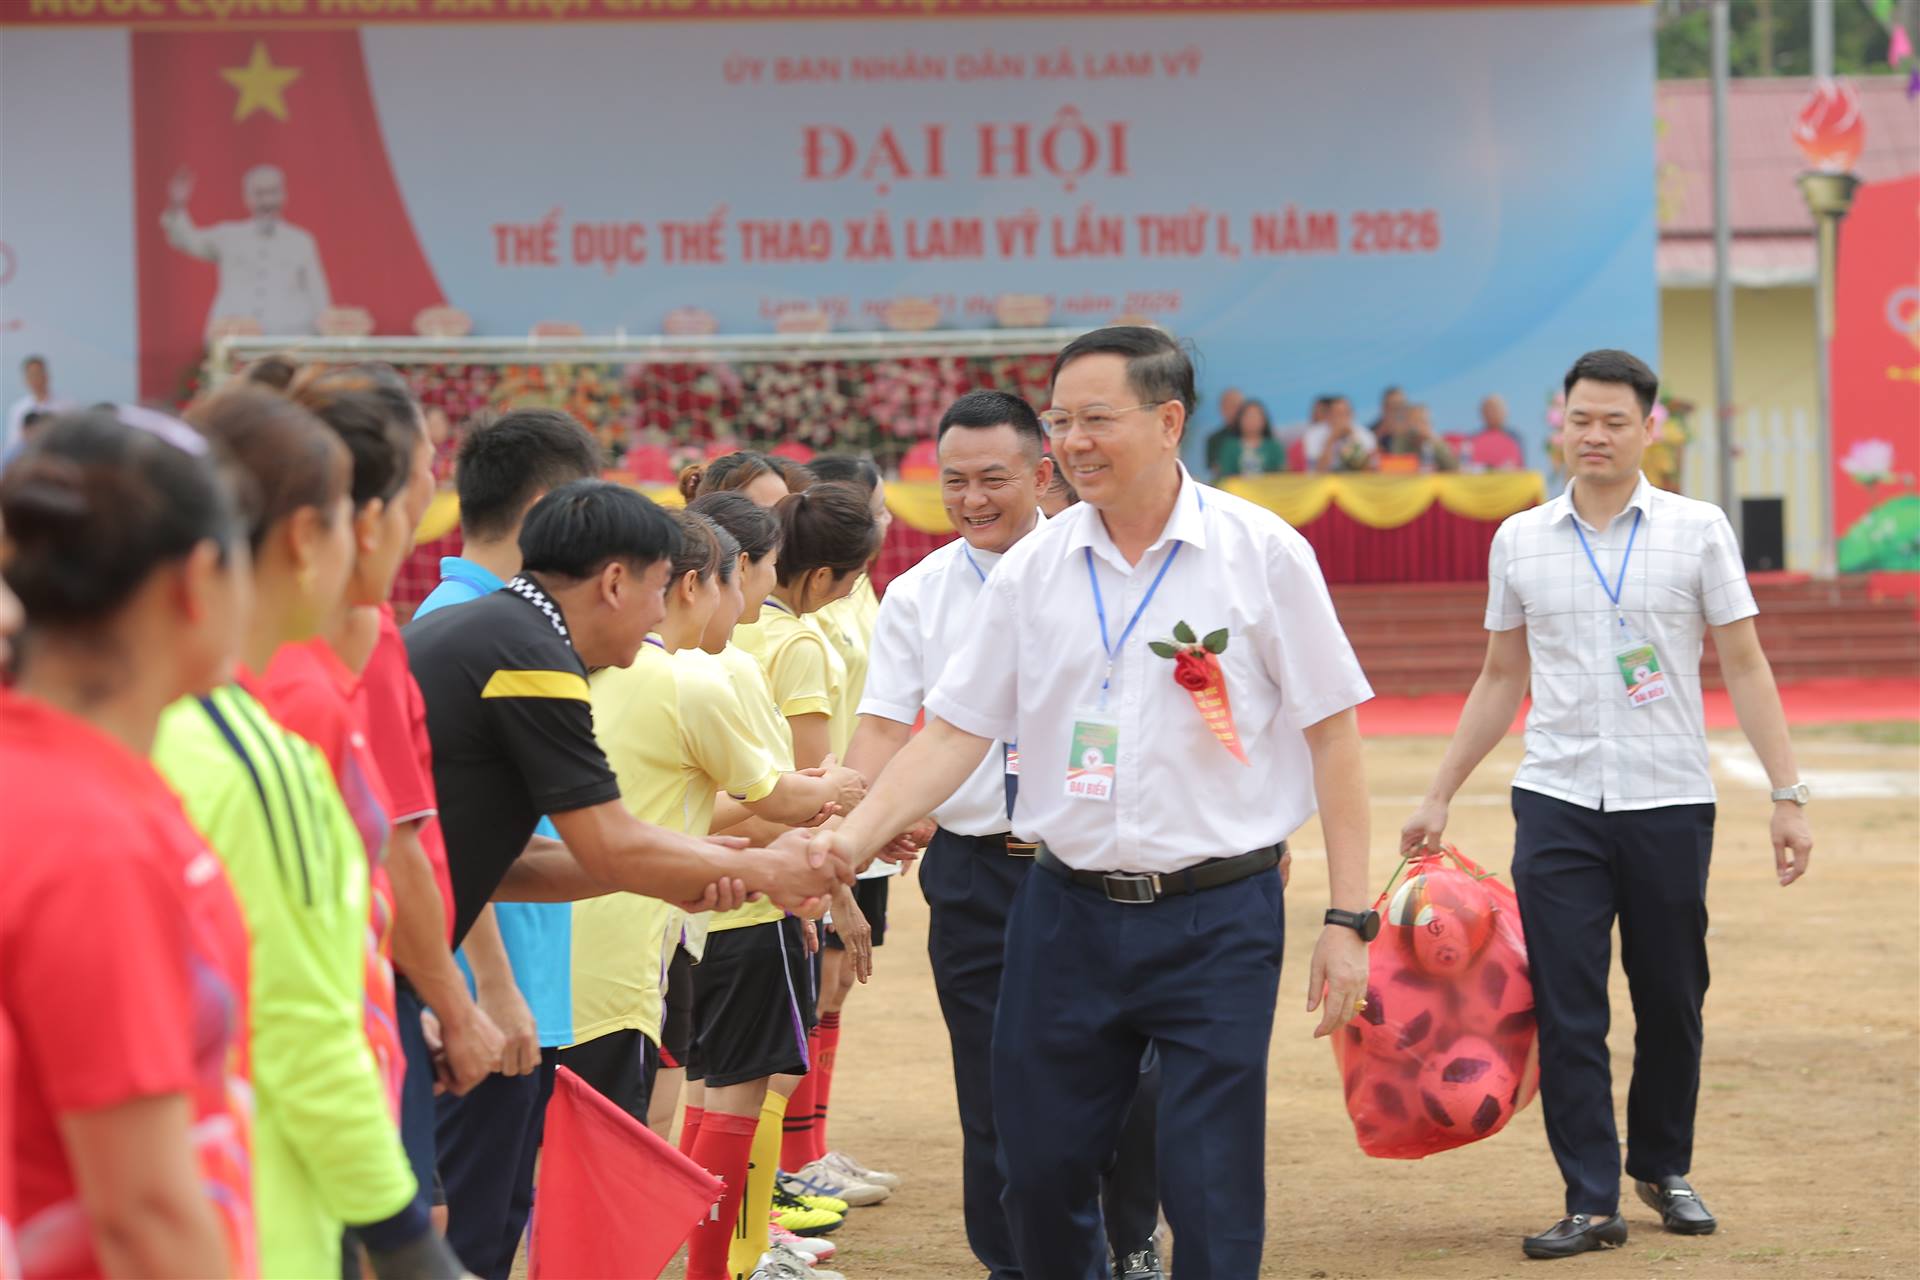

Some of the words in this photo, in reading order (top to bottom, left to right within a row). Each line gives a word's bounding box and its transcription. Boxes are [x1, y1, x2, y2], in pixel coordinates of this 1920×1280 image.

[773, 53, 841, 82] BAN
[851, 48, 946, 81] NHÂN
[955, 47, 1025, 82] DÂN
[1034, 46, 1077, 80] XÃ
[1085, 50, 1152, 79] LAM
[800, 120, 948, 196] ĐẠI
[975, 103, 1131, 194] HỘI
[491, 206, 563, 266] THỂ
[571, 221, 647, 275] DỤC
[658, 203, 729, 265] THỂ
[738, 217, 832, 263] THAO
[843, 208, 893, 263] XÃ
[905, 216, 984, 261] LAM
[995, 205, 1041, 259] VỸ
[1052, 204, 1123, 258] LẦN
[1133, 208, 1210, 256] THỨ
[1251, 204, 1339, 254] NĂM
[1350, 209, 1441, 253] 2026
